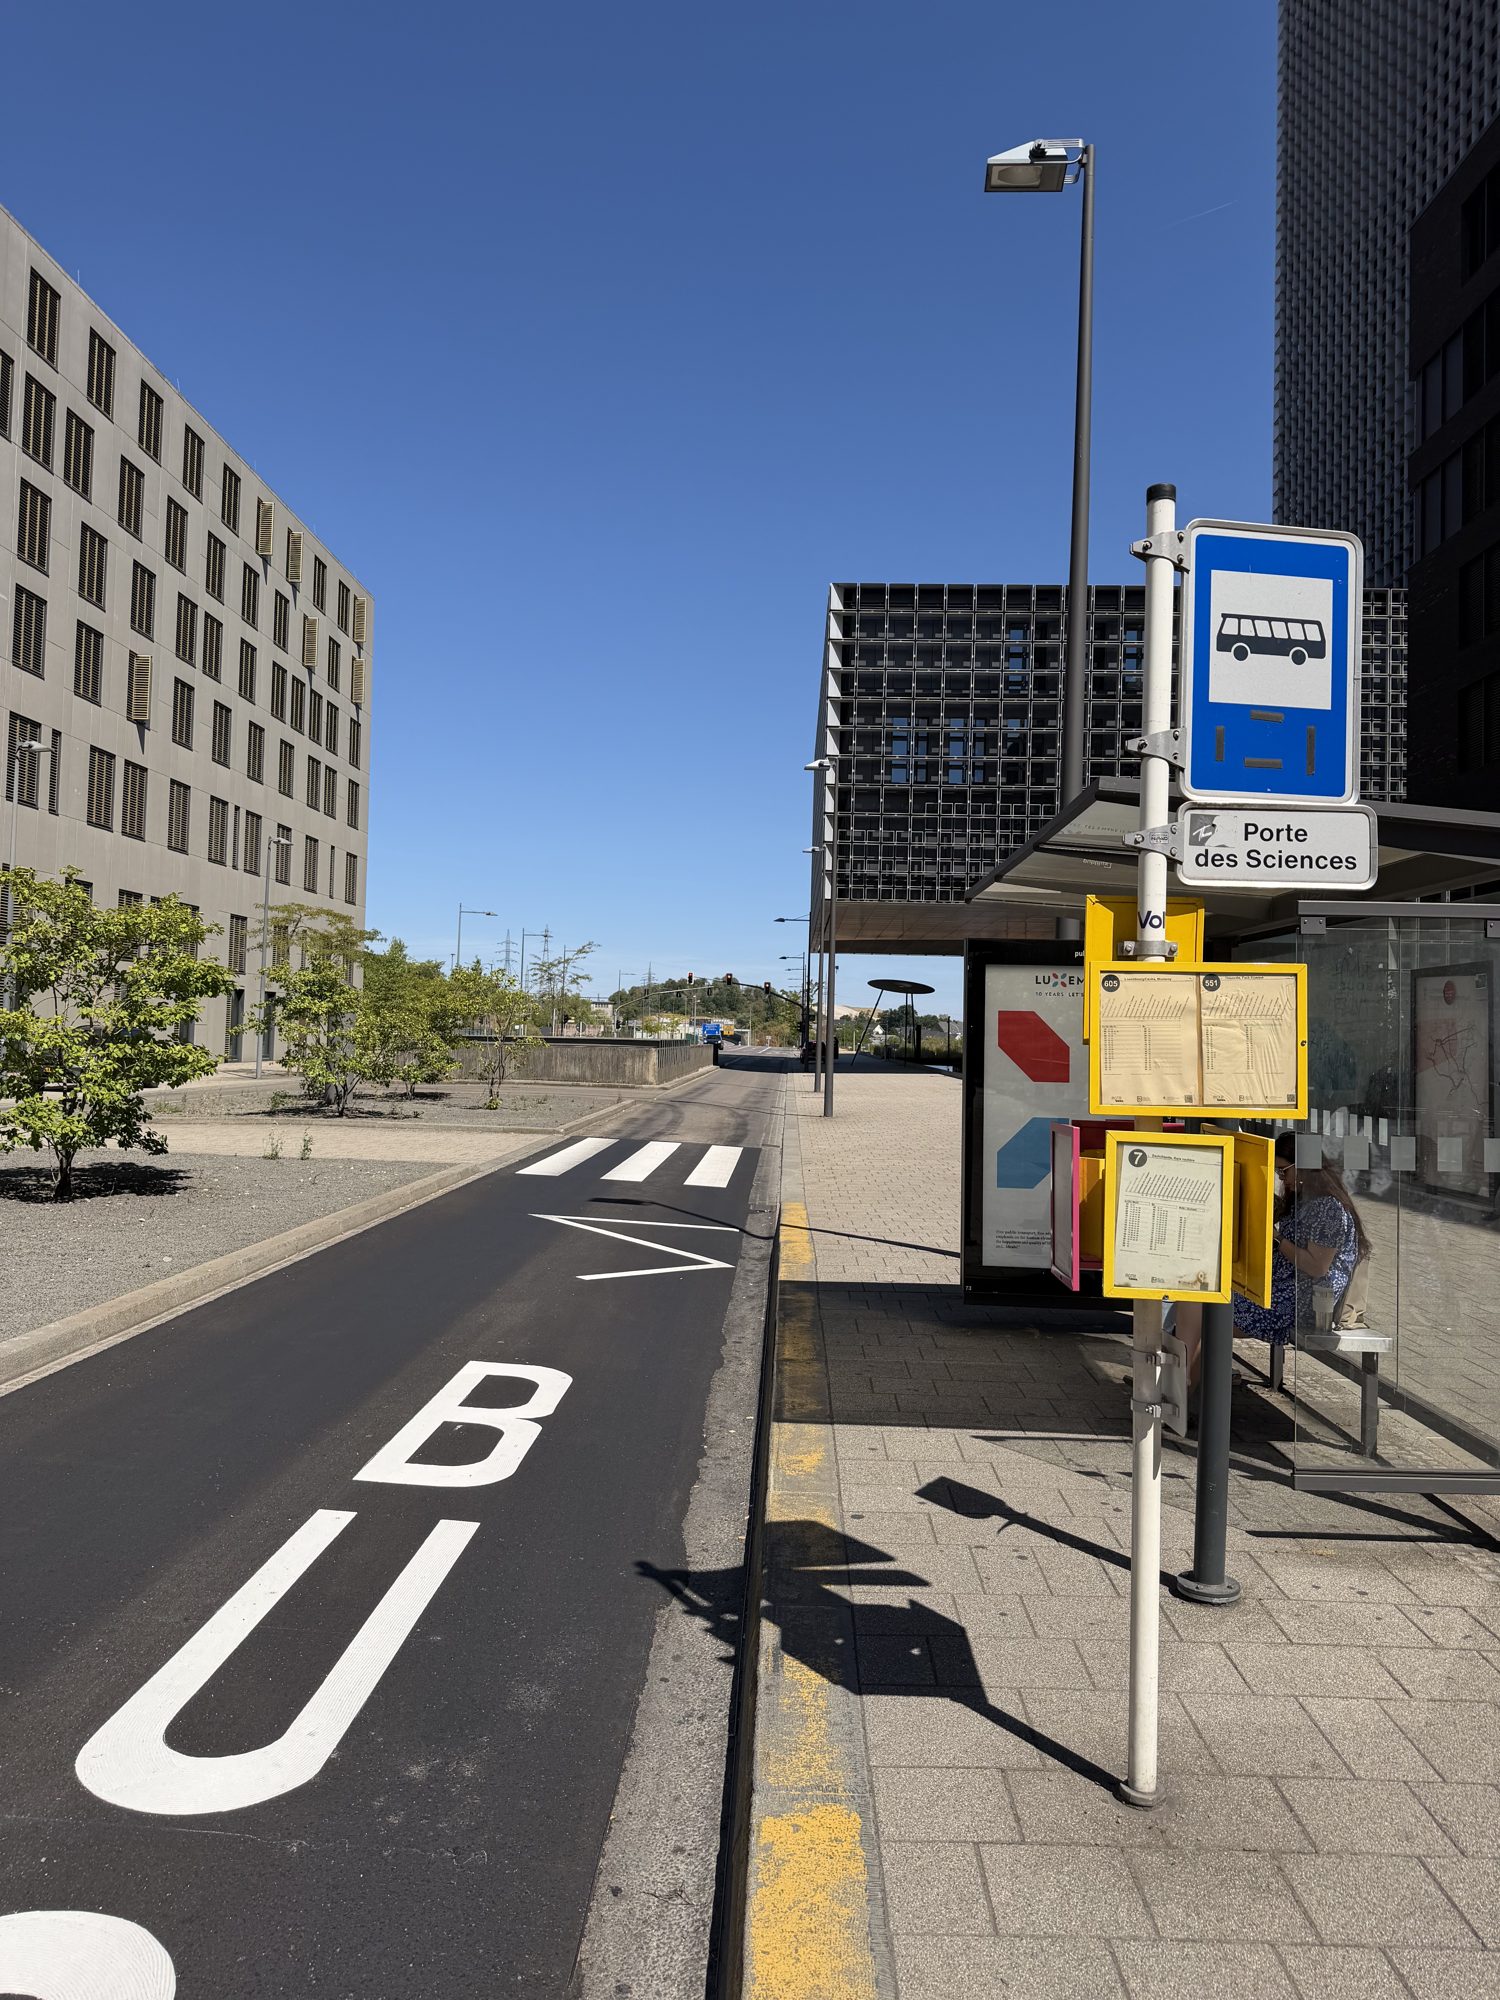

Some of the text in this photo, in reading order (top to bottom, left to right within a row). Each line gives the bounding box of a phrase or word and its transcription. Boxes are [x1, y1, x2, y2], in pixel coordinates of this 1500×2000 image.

[1244, 822, 1308, 843] Porte
[1195, 849, 1357, 870] des Sciences
[1137, 910, 1165, 929] Vol
[1103, 979, 1118, 988] 605
[1204, 979, 1219, 988] 551
[1133, 1151, 1143, 1165] 7
